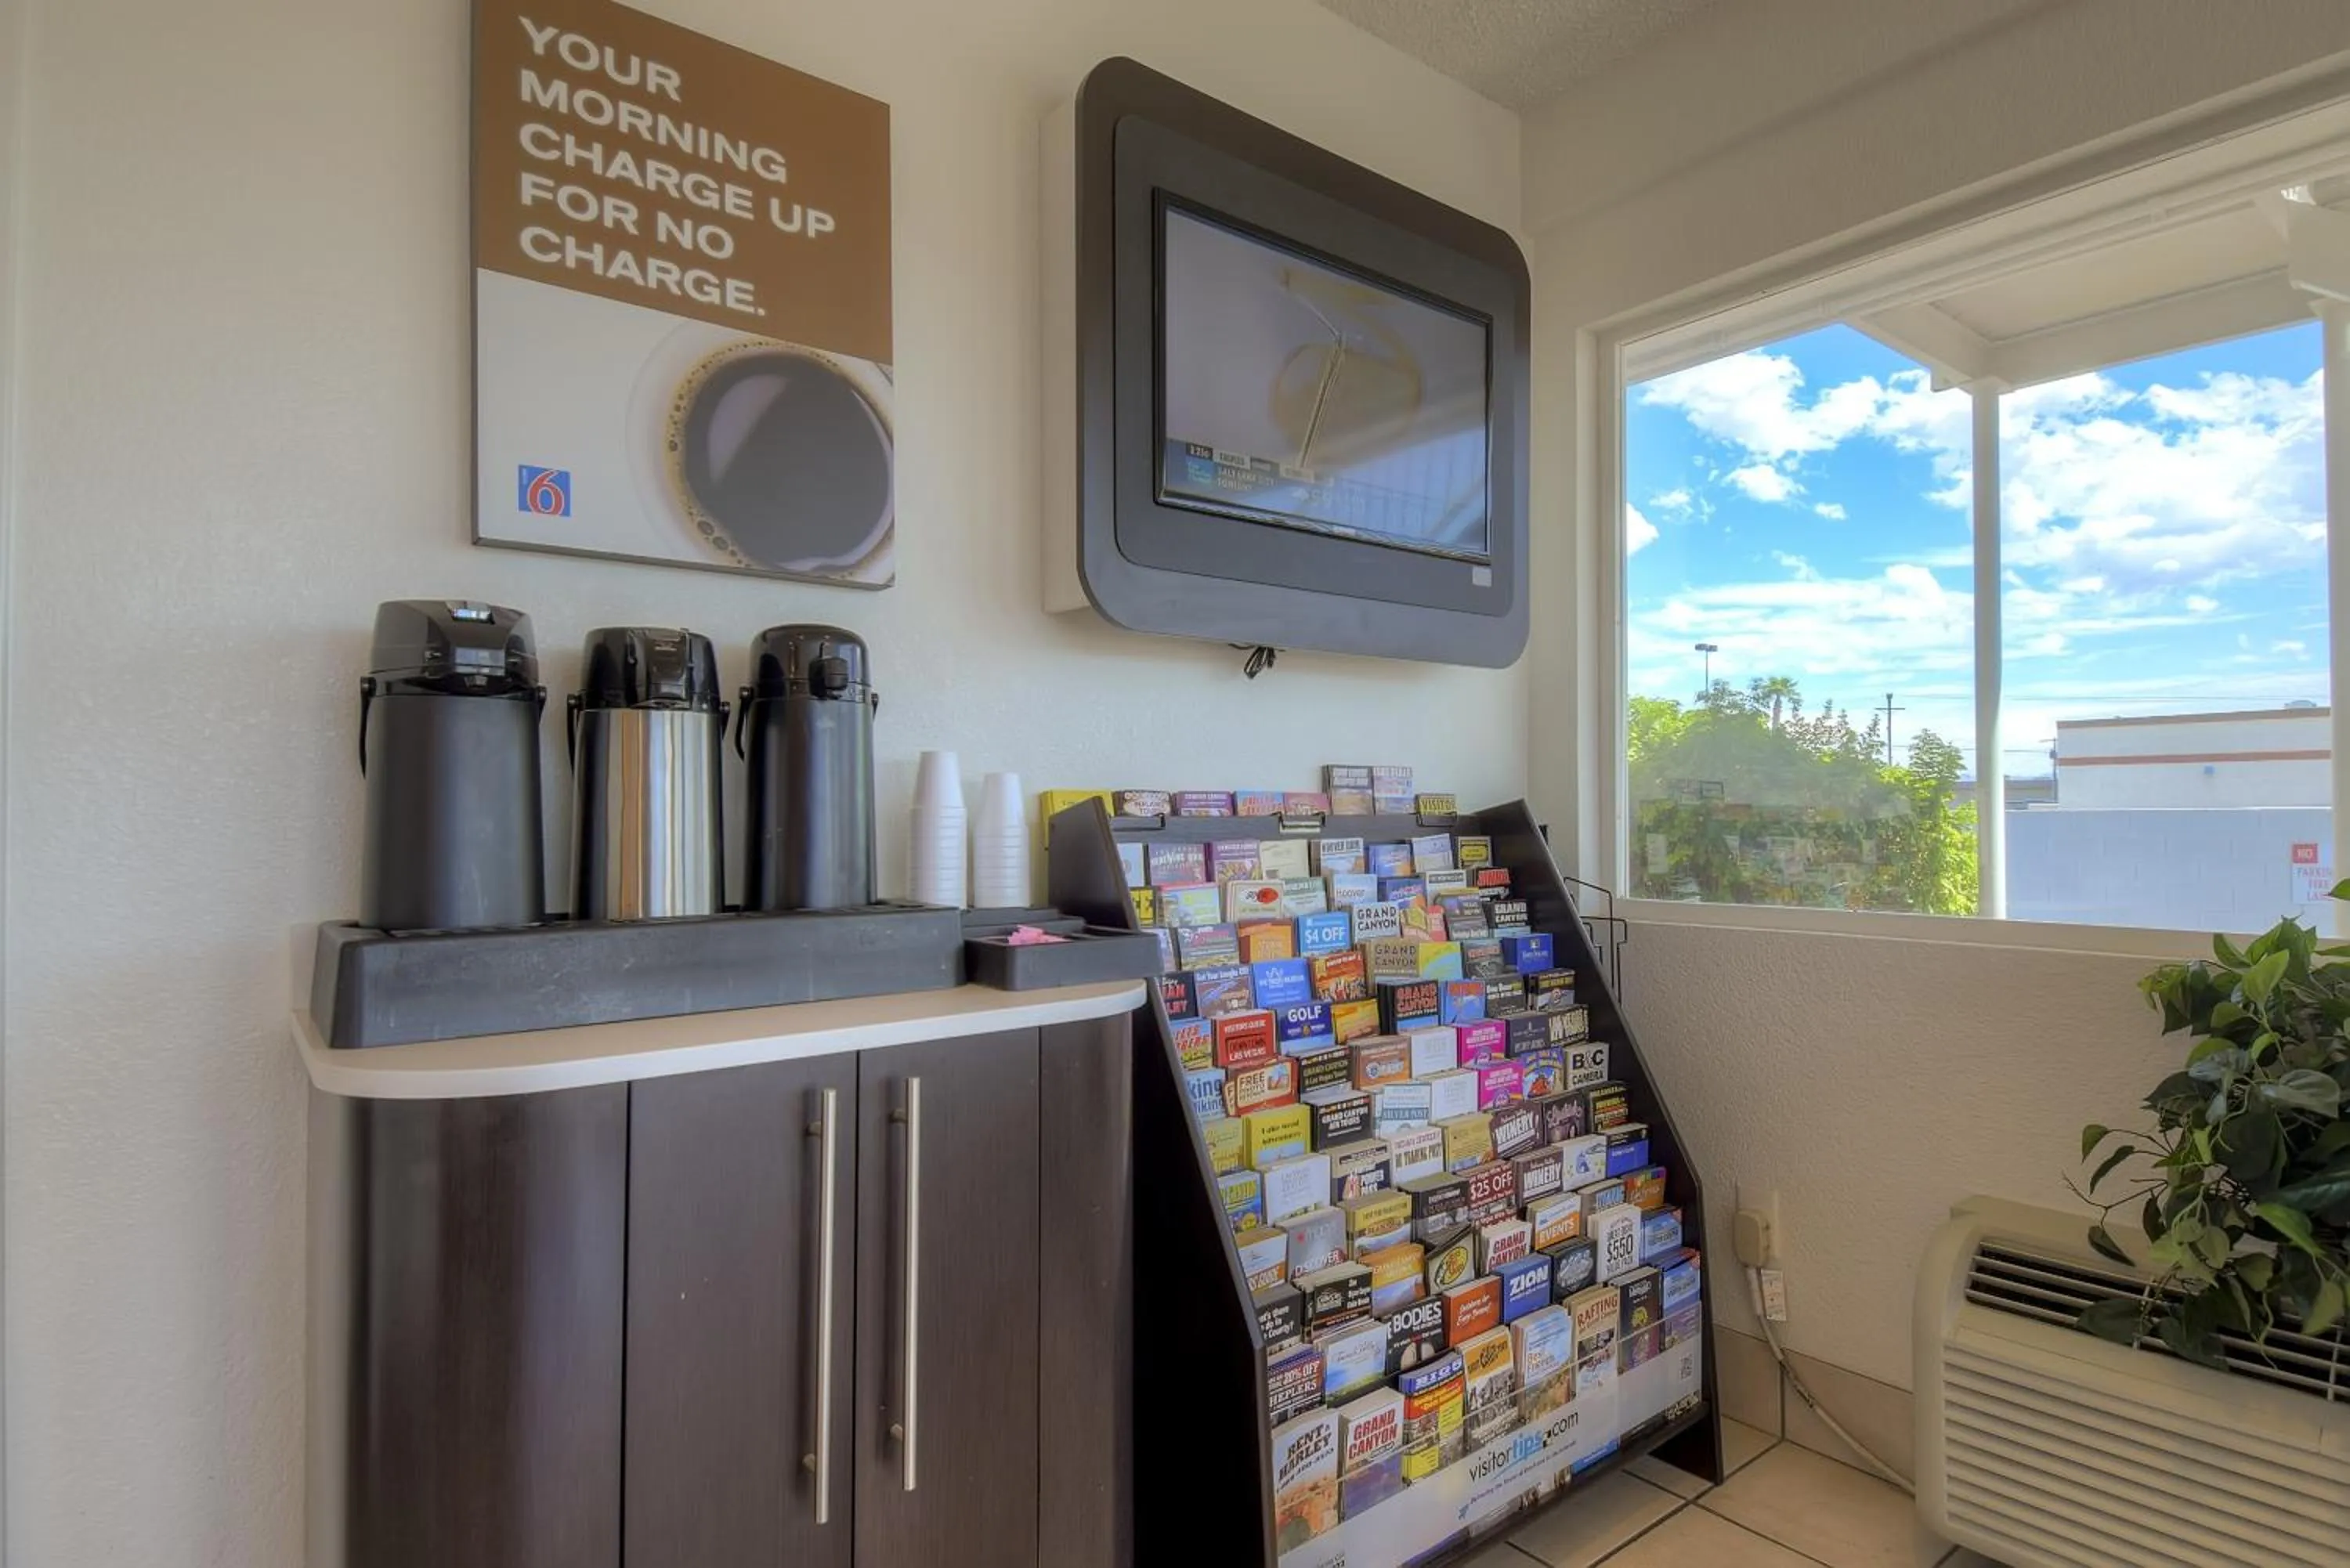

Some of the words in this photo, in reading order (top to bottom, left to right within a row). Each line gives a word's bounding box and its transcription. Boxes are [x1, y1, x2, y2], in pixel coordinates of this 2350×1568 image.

[519, 16, 682, 102] YOUR
[519, 70, 787, 183] MORNING
[519, 123, 754, 220] CHARGE
[769, 197, 836, 238] UP
[520, 172, 640, 235] FOR
[657, 216, 735, 260] NO
[519, 226, 765, 316] CHARGE.
[526, 469, 566, 515] 6
[1358, 905, 1397, 919] GRAND
[1495, 901, 1527, 913] GRAND
[1305, 929, 1319, 944] $4
[1322, 927, 1346, 941] OFF
[1358, 918, 1397, 932] CANYON
[1376, 945, 1417, 956] GRAND
[1376, 956, 1417, 966] CANYON
[1397, 984, 1437, 999] GRAND
[1288, 1006, 1322, 1022] GOLF
[1397, 997, 1437, 1012] CANYON
[1187, 1078, 1221, 1100] king
[1240, 1071, 1265, 1084] FREE
[1572, 1072, 1604, 1086] CAMERA
[1321, 1112, 1342, 1125] GRAND
[1343, 1107, 1368, 1119] CANYON
[1341, 1116, 1361, 1128] TOURS
[1496, 1114, 1534, 1143] WINERY
[1470, 1180, 1490, 1201] $25
[1493, 1170, 1513, 1190] OFF
[1524, 1162, 1561, 1190] WINERY
[1493, 1231, 1526, 1254] GRAND
[1539, 1218, 1574, 1243] EVENTS
[1489, 1245, 1527, 1268] CANYON
[1607, 1234, 1633, 1263] $550
[1509, 1265, 1549, 1296] ZION
[1394, 1301, 1442, 1333] BODIES
[1577, 1295, 1618, 1327] RAFTING
[1303, 1360, 1320, 1377] OFF
[1353, 1409, 1396, 1440] GRAND
[1287, 1423, 1325, 1460] RENT
[1349, 1424, 1397, 1460] CANYON
[1278, 1433, 1332, 1481] HARLEY
